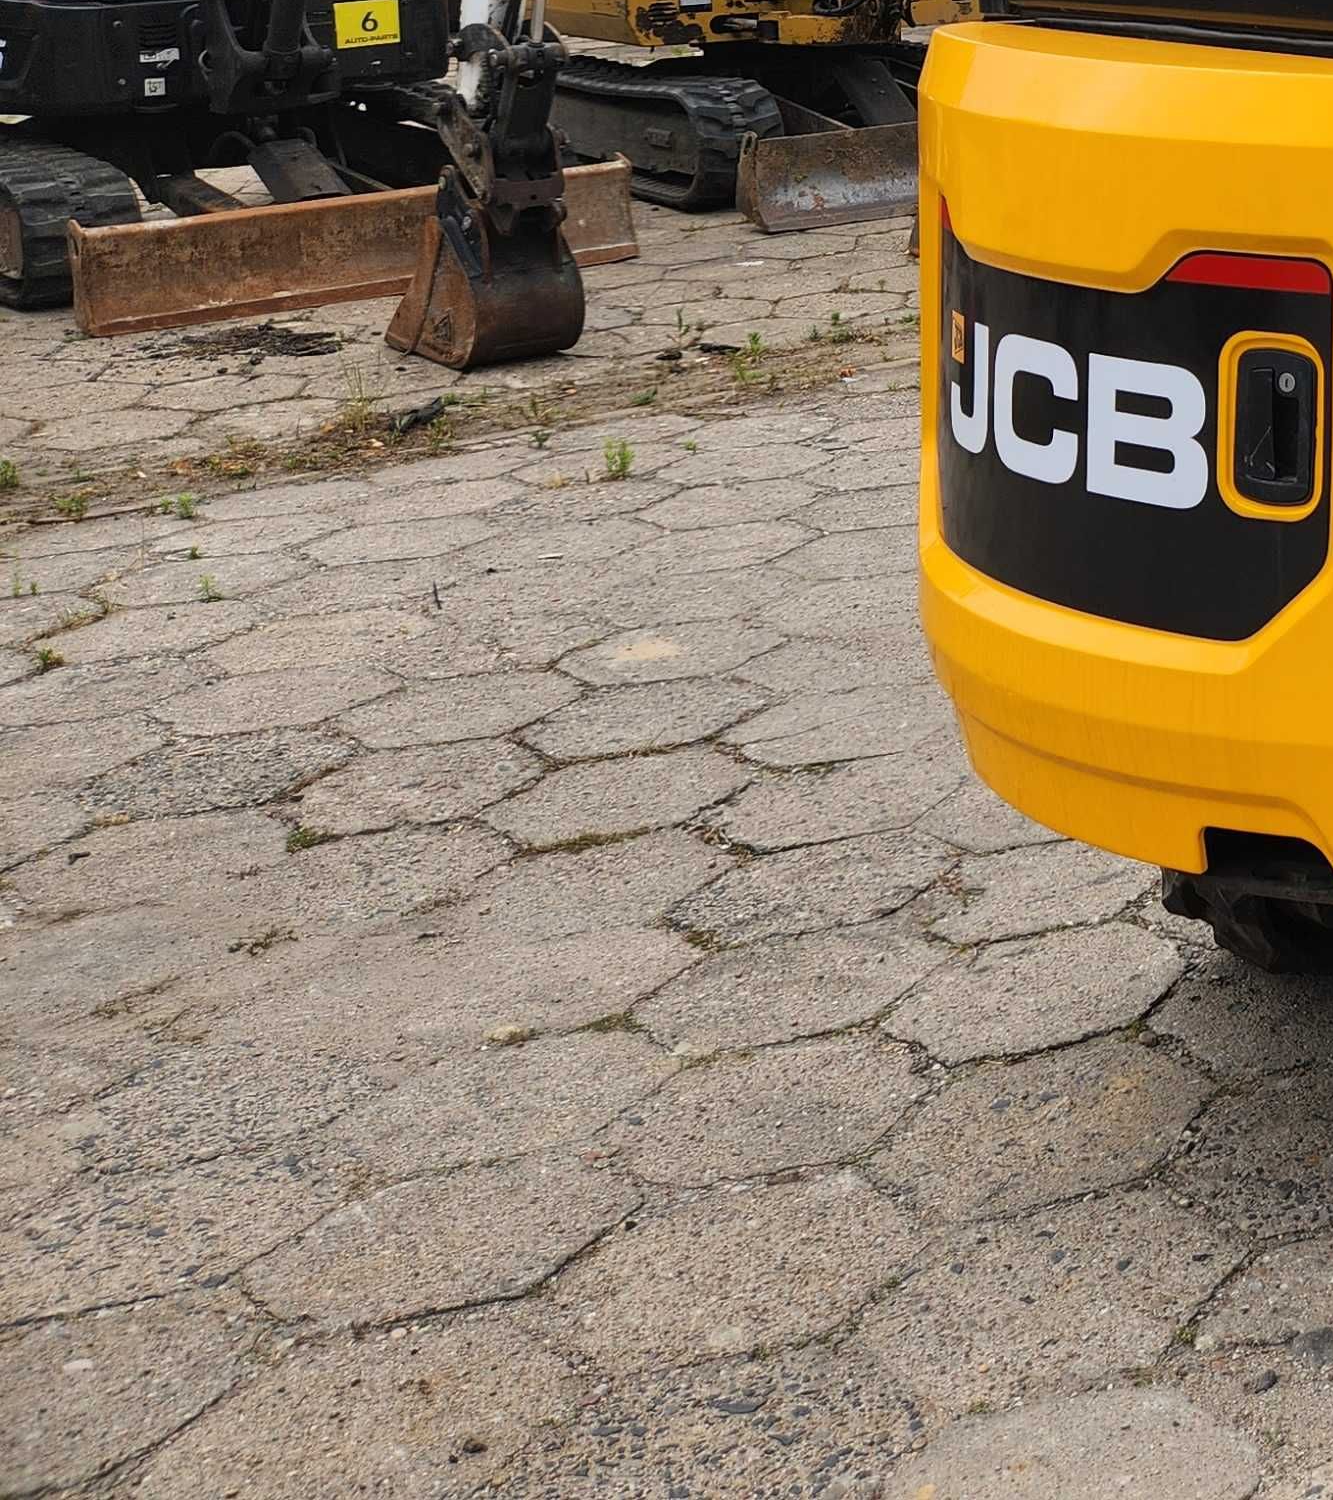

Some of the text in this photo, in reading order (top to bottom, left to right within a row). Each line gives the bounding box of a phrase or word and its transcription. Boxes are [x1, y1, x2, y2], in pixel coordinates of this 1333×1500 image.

[361, 11, 378, 32] 6
[344, 33, 398, 44] AUTO-PARTS
[951, 321, 1209, 510] JCB
